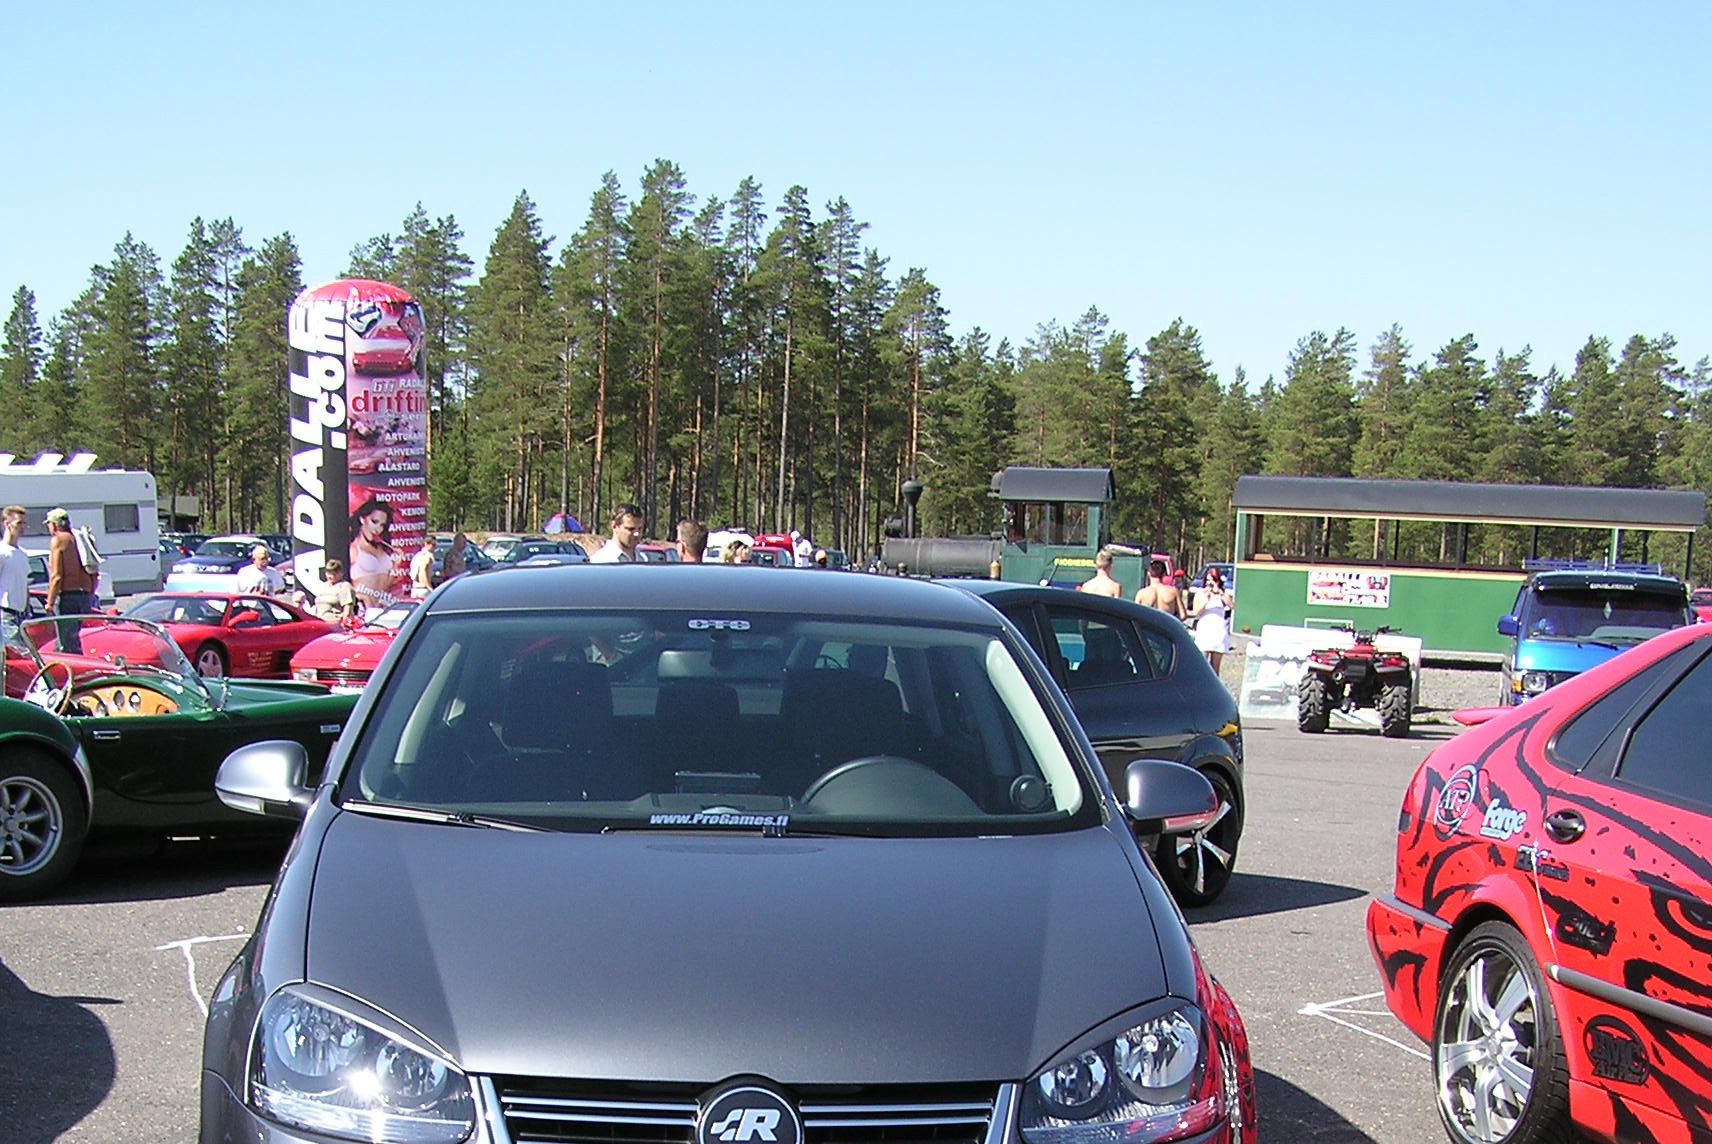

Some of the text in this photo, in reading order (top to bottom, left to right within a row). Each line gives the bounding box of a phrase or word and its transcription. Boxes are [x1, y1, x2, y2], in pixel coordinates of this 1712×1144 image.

[317, 300, 347, 451] .com
[290, 301, 326, 612] ADALLE
[650, 813, 789, 827] www.ProGames.fi
